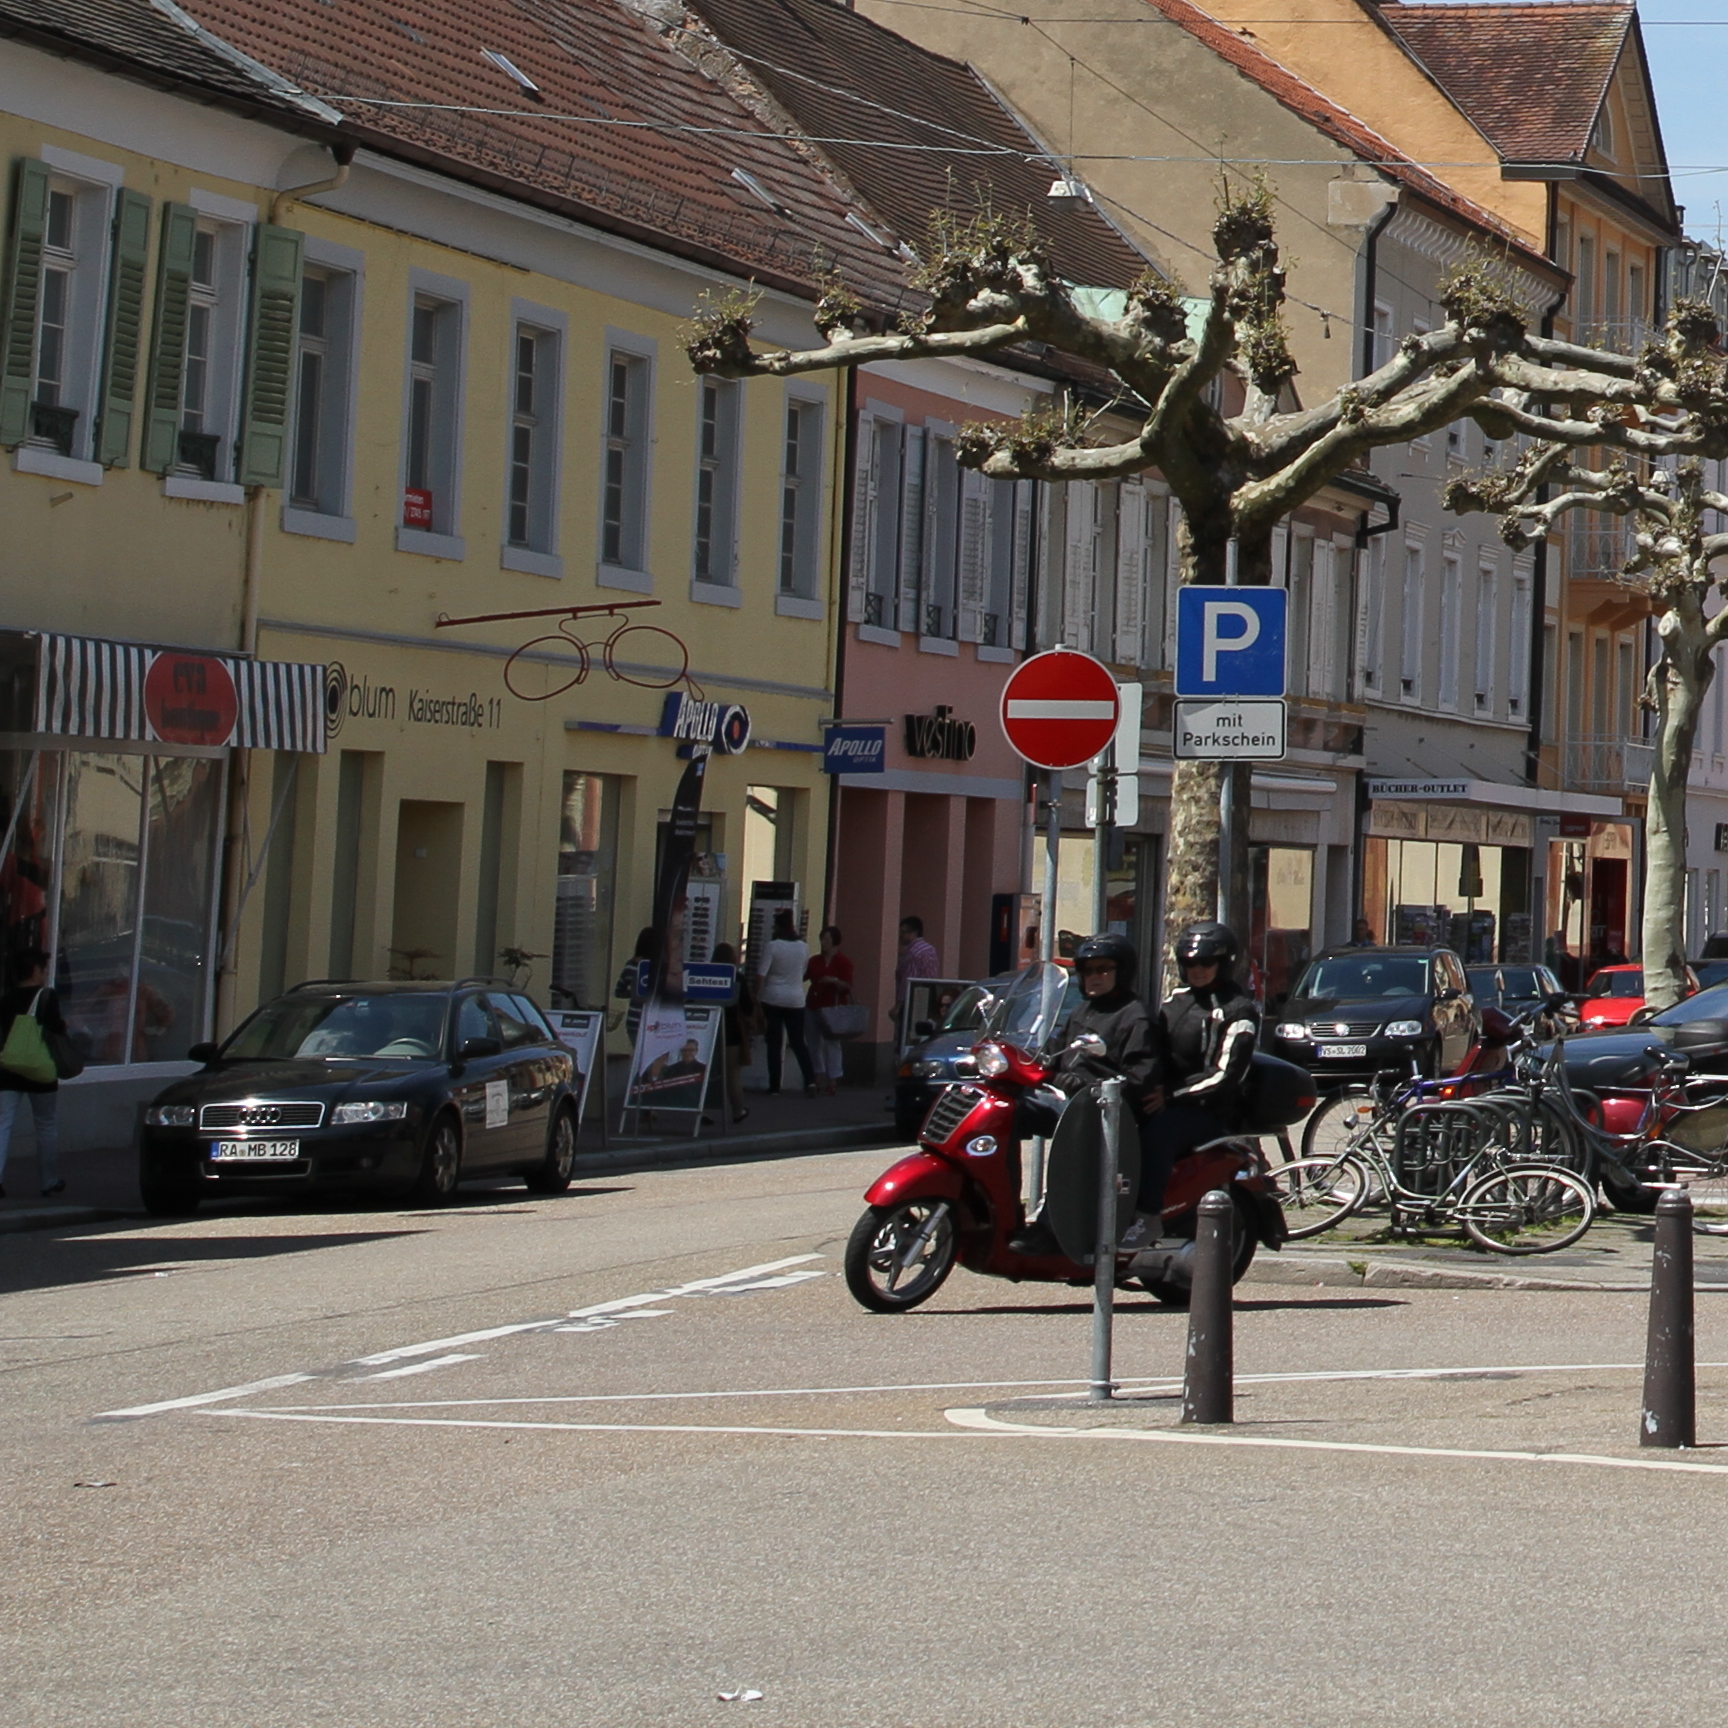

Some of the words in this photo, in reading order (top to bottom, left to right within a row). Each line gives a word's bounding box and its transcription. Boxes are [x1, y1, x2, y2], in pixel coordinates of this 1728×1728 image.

[1203, 601, 1261, 682] P
[349, 674, 395, 720] blum
[408, 689, 485, 728] Kaiserstraße
[488, 697, 502, 729] 11
[673, 692, 719, 742] APOLLO
[1216, 714, 1243, 728] mit
[827, 738, 883, 756] APOLLO
[1182, 732, 1276, 747] Parkschein
[1371, 782, 1467, 794] BÜCHER-OUTLET
[688, 976, 729, 987] Sehtest
[220, 1143, 238, 1157] RA
[247, 1143, 267, 1157] MB
[269, 1142, 297, 1157] 128
